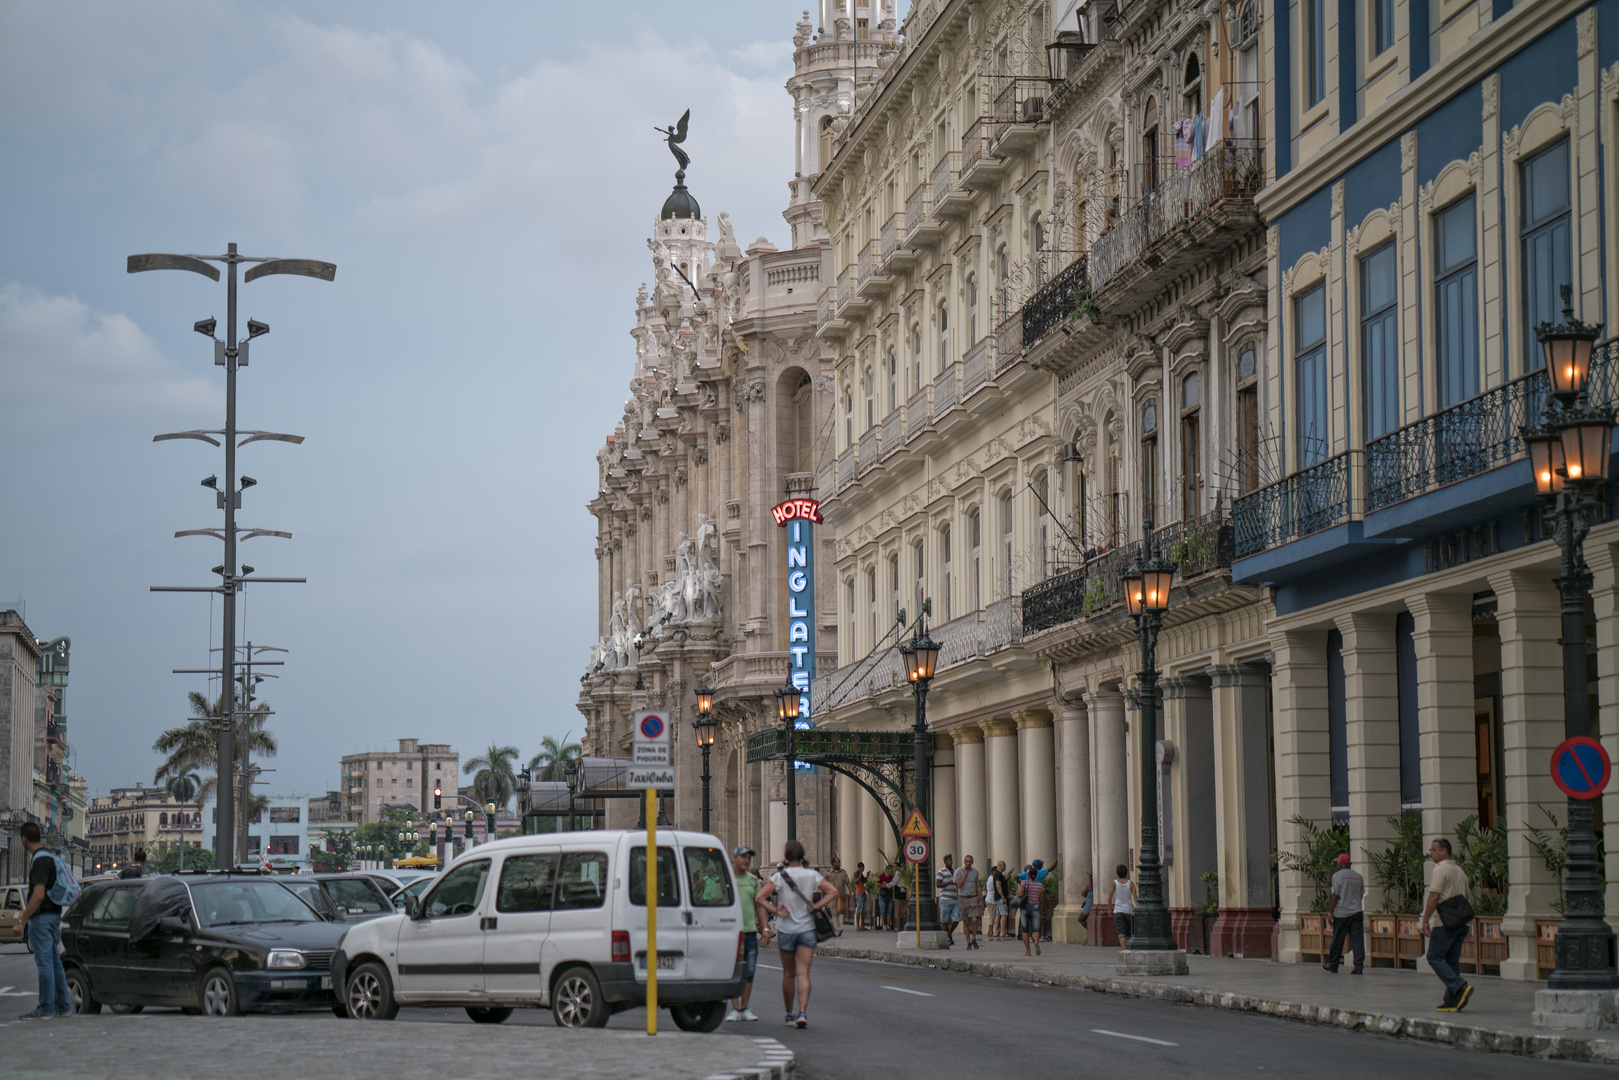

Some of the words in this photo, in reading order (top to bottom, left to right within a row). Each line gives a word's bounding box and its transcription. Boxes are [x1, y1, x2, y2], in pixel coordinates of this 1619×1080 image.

[772, 500, 818, 524] HOTEL
[1423, 521, 1500, 573] HOTEL
[630, 772, 673, 783] TaxiCuba
[909, 846, 924, 855] 30
